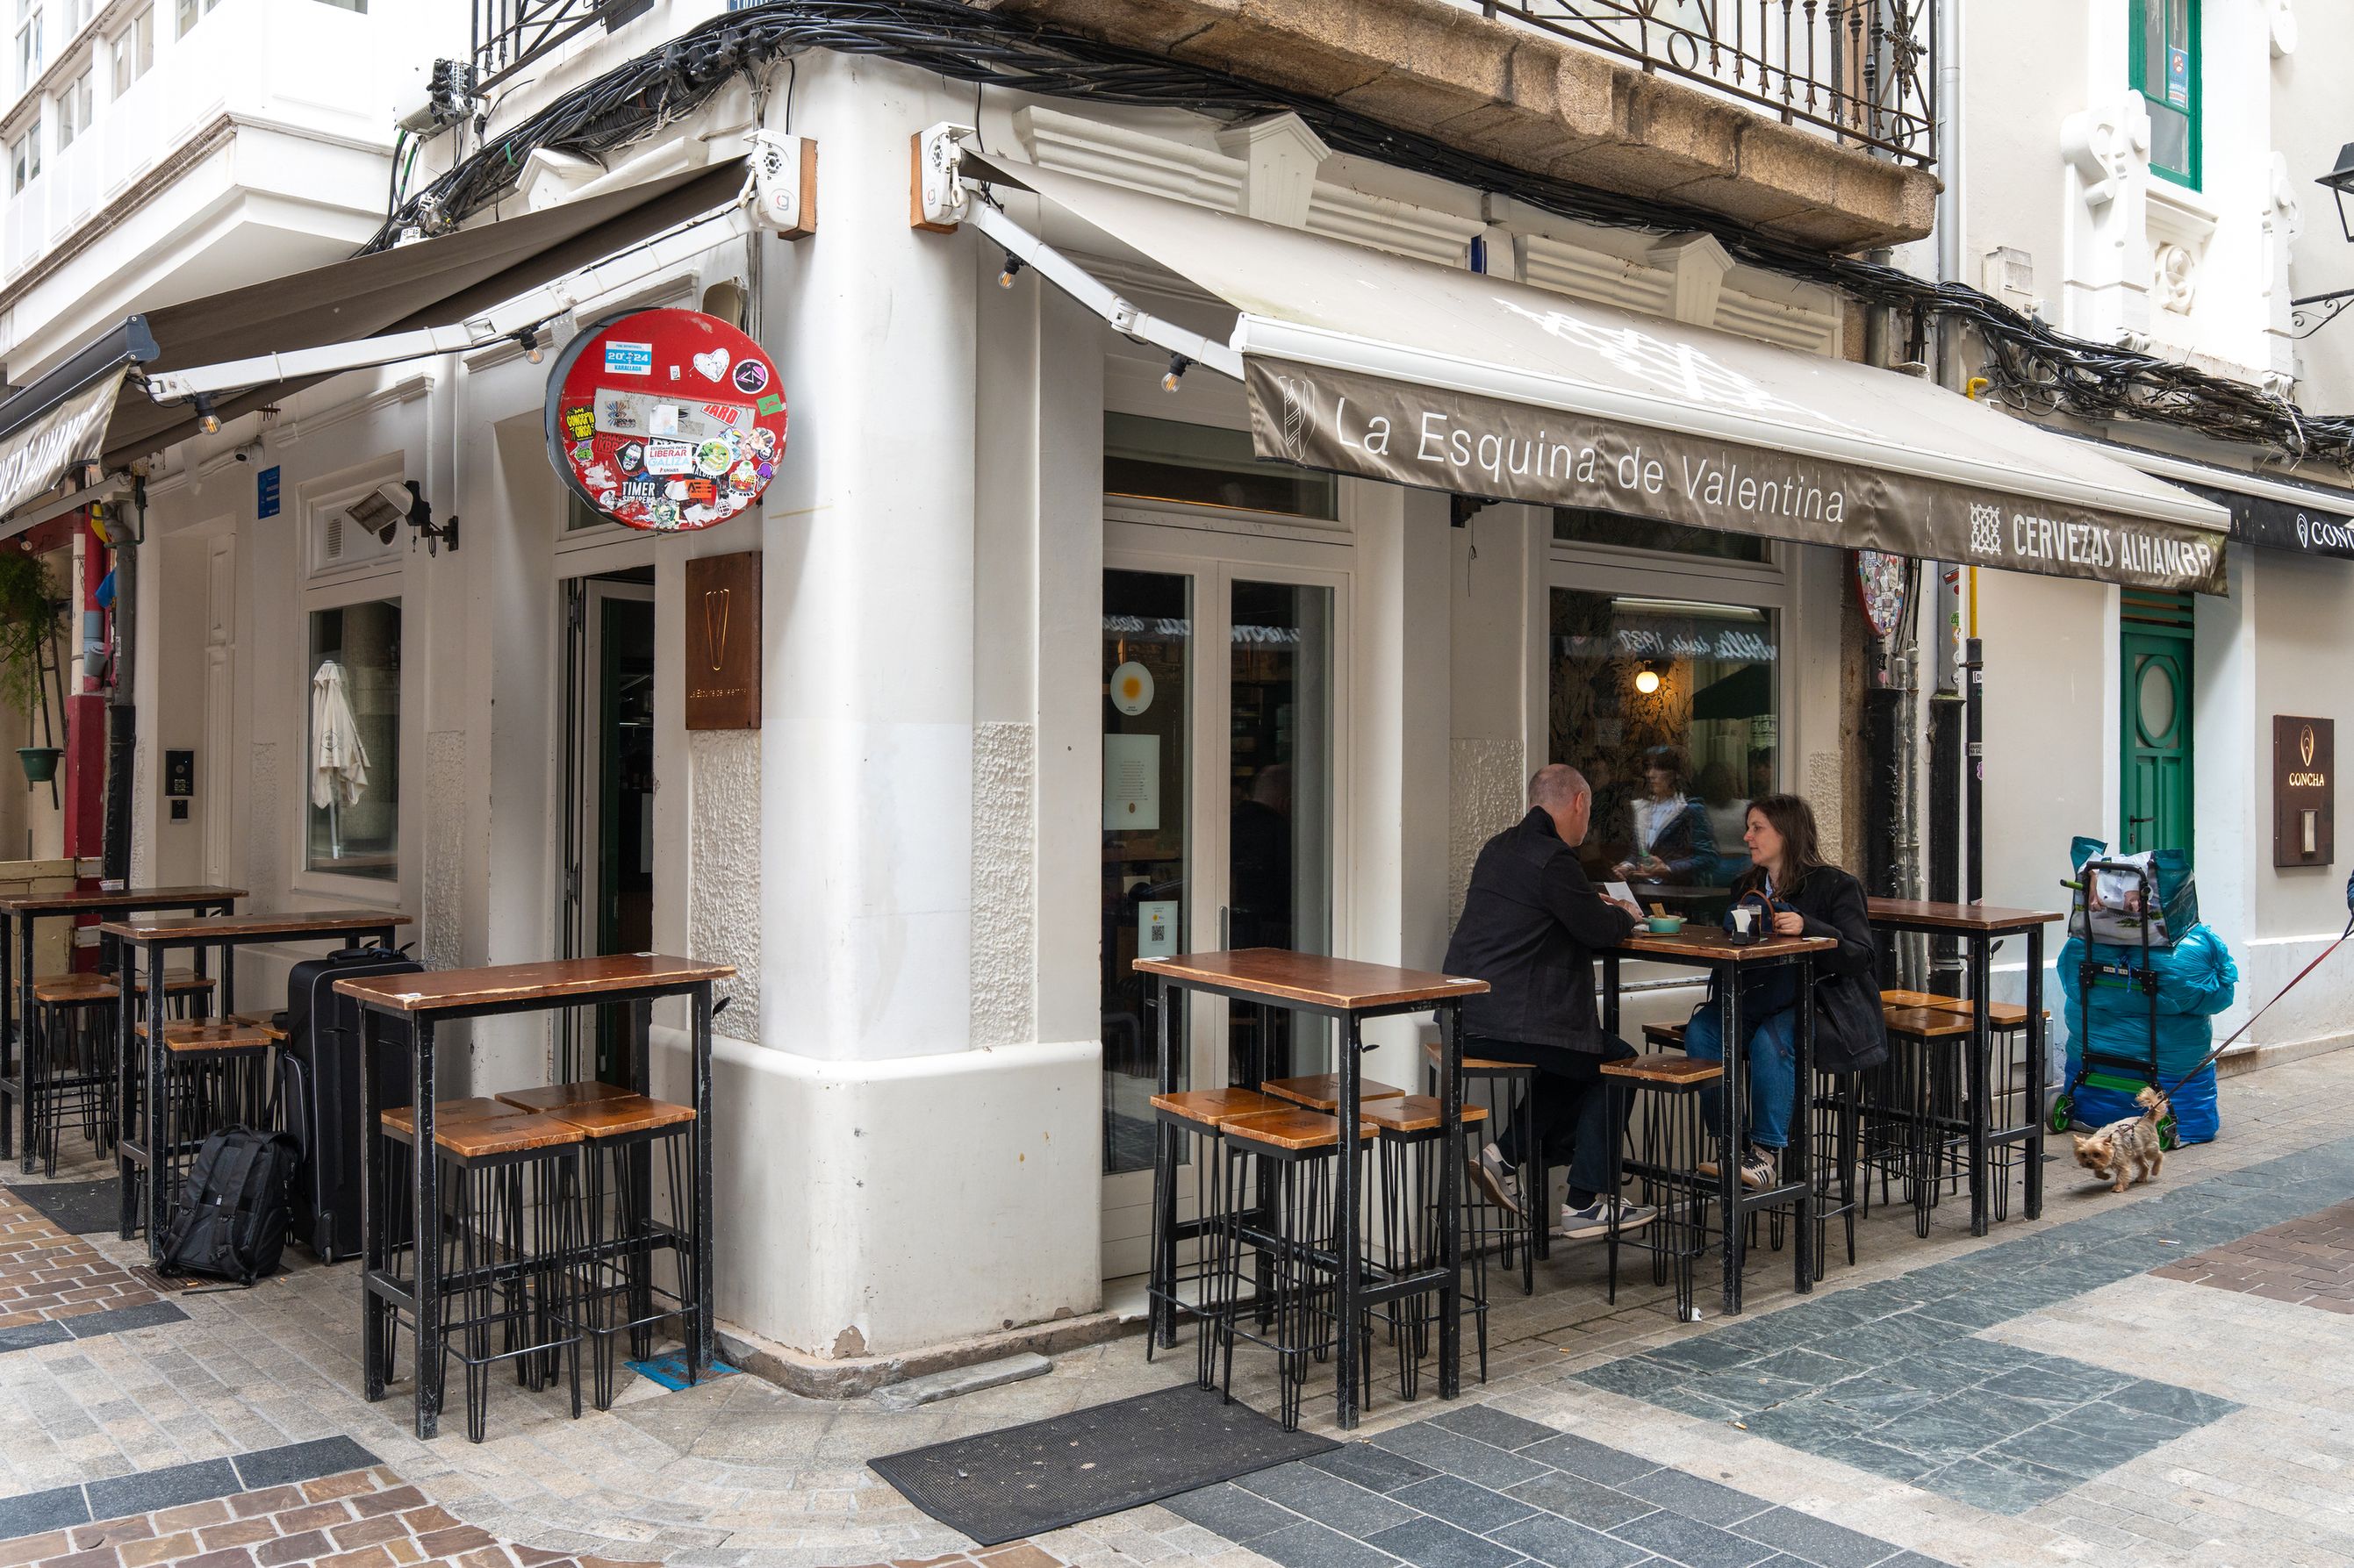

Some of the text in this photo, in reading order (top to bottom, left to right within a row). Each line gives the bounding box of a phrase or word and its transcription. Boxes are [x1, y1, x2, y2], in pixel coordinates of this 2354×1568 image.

[1334, 397, 1844, 523] La Esquina de Valentina
[622, 482, 656, 496] TIMER
[2013, 513, 2212, 576] CERVEZAS ALHAMBR
[2289, 772, 2324, 786] CONCHA
